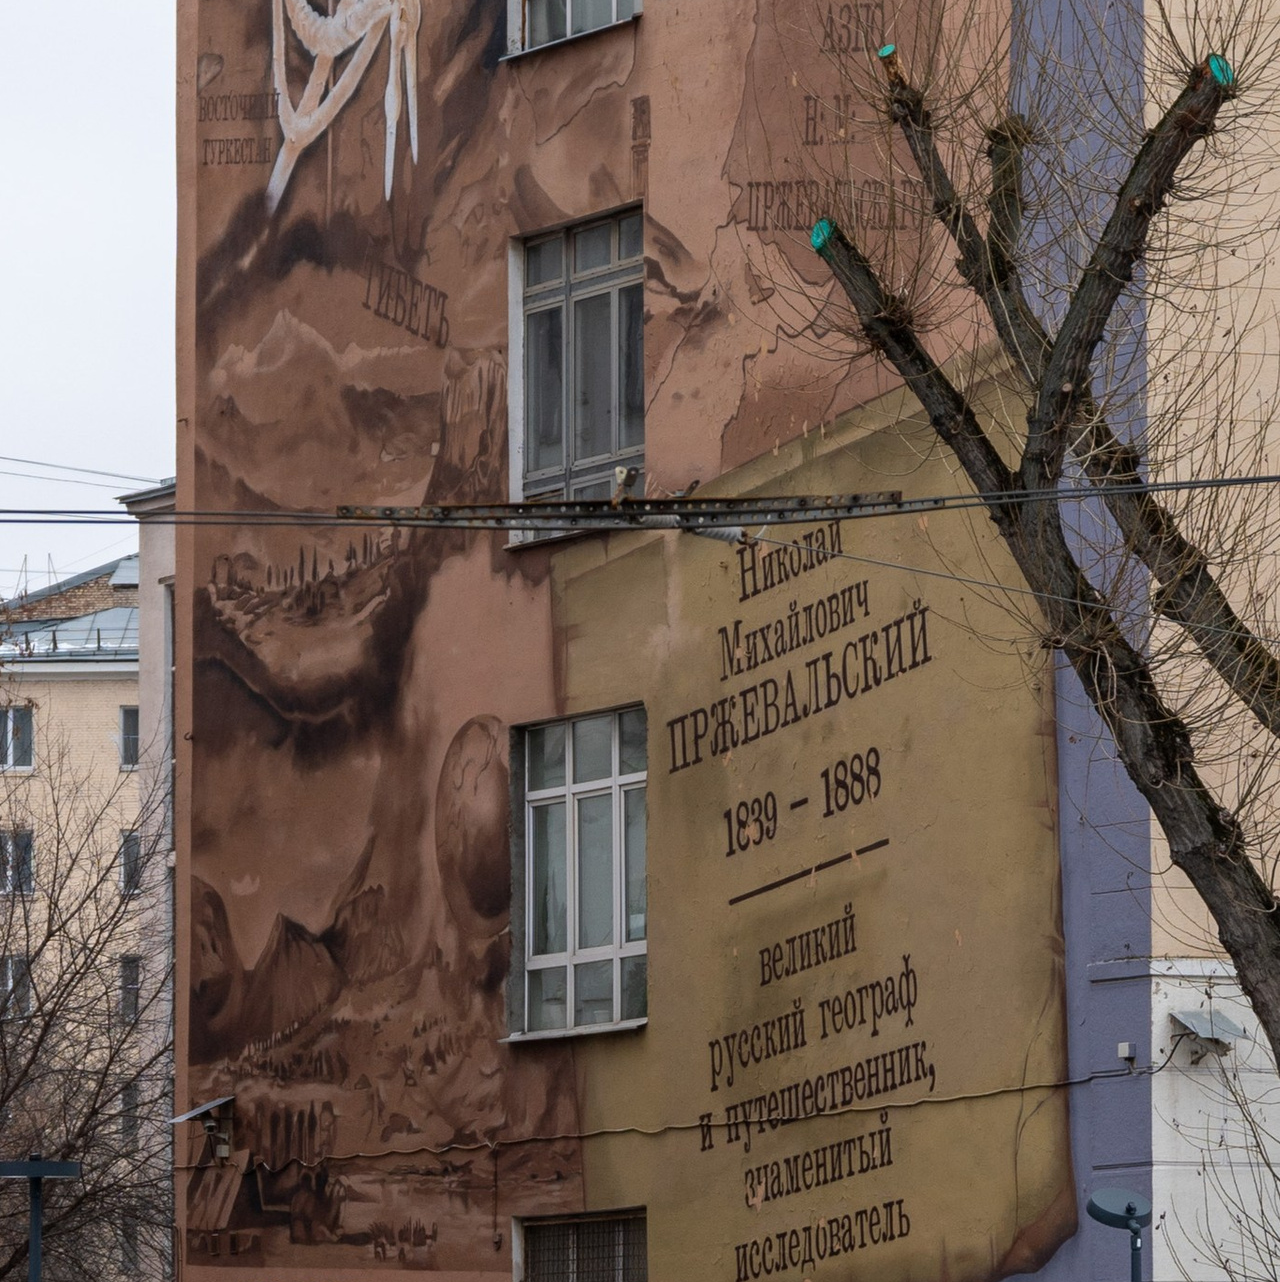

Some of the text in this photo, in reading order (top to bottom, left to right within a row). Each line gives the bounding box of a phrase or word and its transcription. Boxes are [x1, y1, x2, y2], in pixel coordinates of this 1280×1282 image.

[736, 518, 844, 604] Николай
[718, 579, 870, 682] Михайлович
[666, 598, 933, 775] ПРЖЕВАЛЬСКИЙ
[723, 790, 778, 857] 1839
[820, 747, 881, 818] 1888
[759, 902, 858, 987] великий
[708, 954, 919, 1093] русский географ
[699, 1039, 937, 1154] и путешественник,
[744, 1111, 894, 1209] знаменитый
